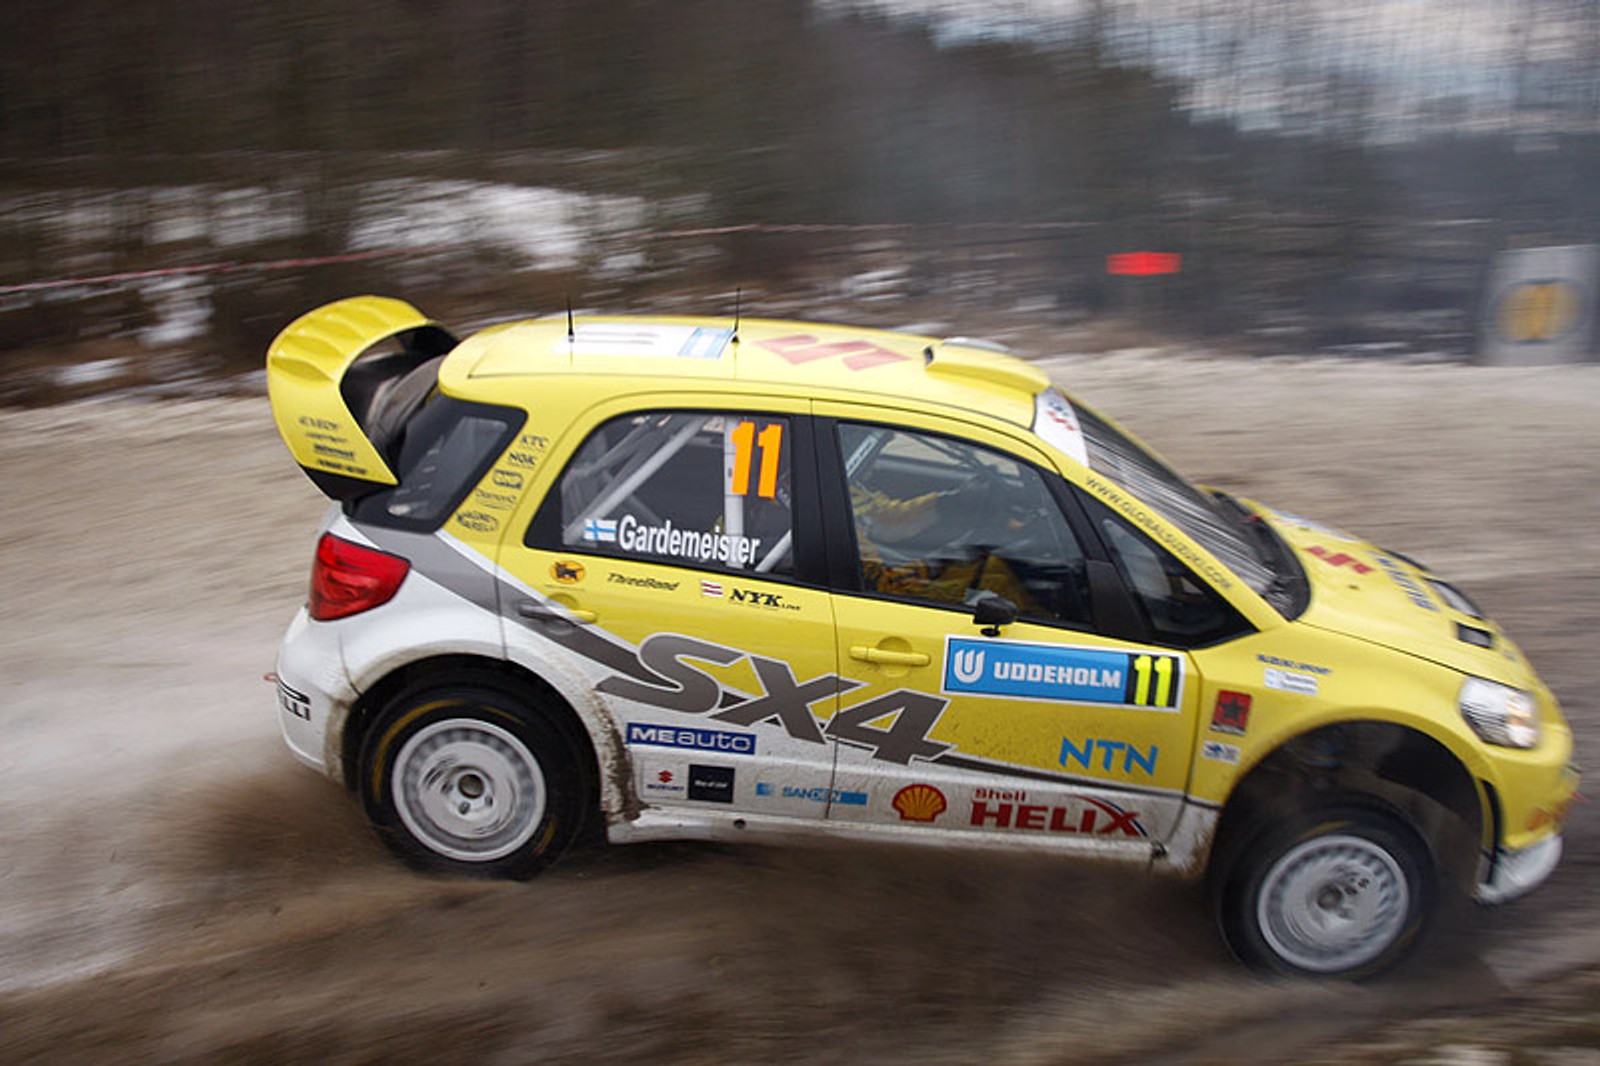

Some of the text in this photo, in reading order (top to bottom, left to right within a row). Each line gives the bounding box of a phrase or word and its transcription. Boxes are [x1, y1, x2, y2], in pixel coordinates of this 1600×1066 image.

[731, 421, 782, 498] 11
[619, 514, 760, 564] Gardemeister
[606, 572, 680, 592] ThreeBond
[730, 588, 784, 608] NYK
[596, 632, 957, 767] SX4
[993, 661, 1122, 689] UDDEHOLM
[1134, 653, 1173, 708] 11
[1058, 735, 1160, 777] NTN
[969, 794, 1146, 838] HELIX
[974, 787, 1027, 802] Shell
